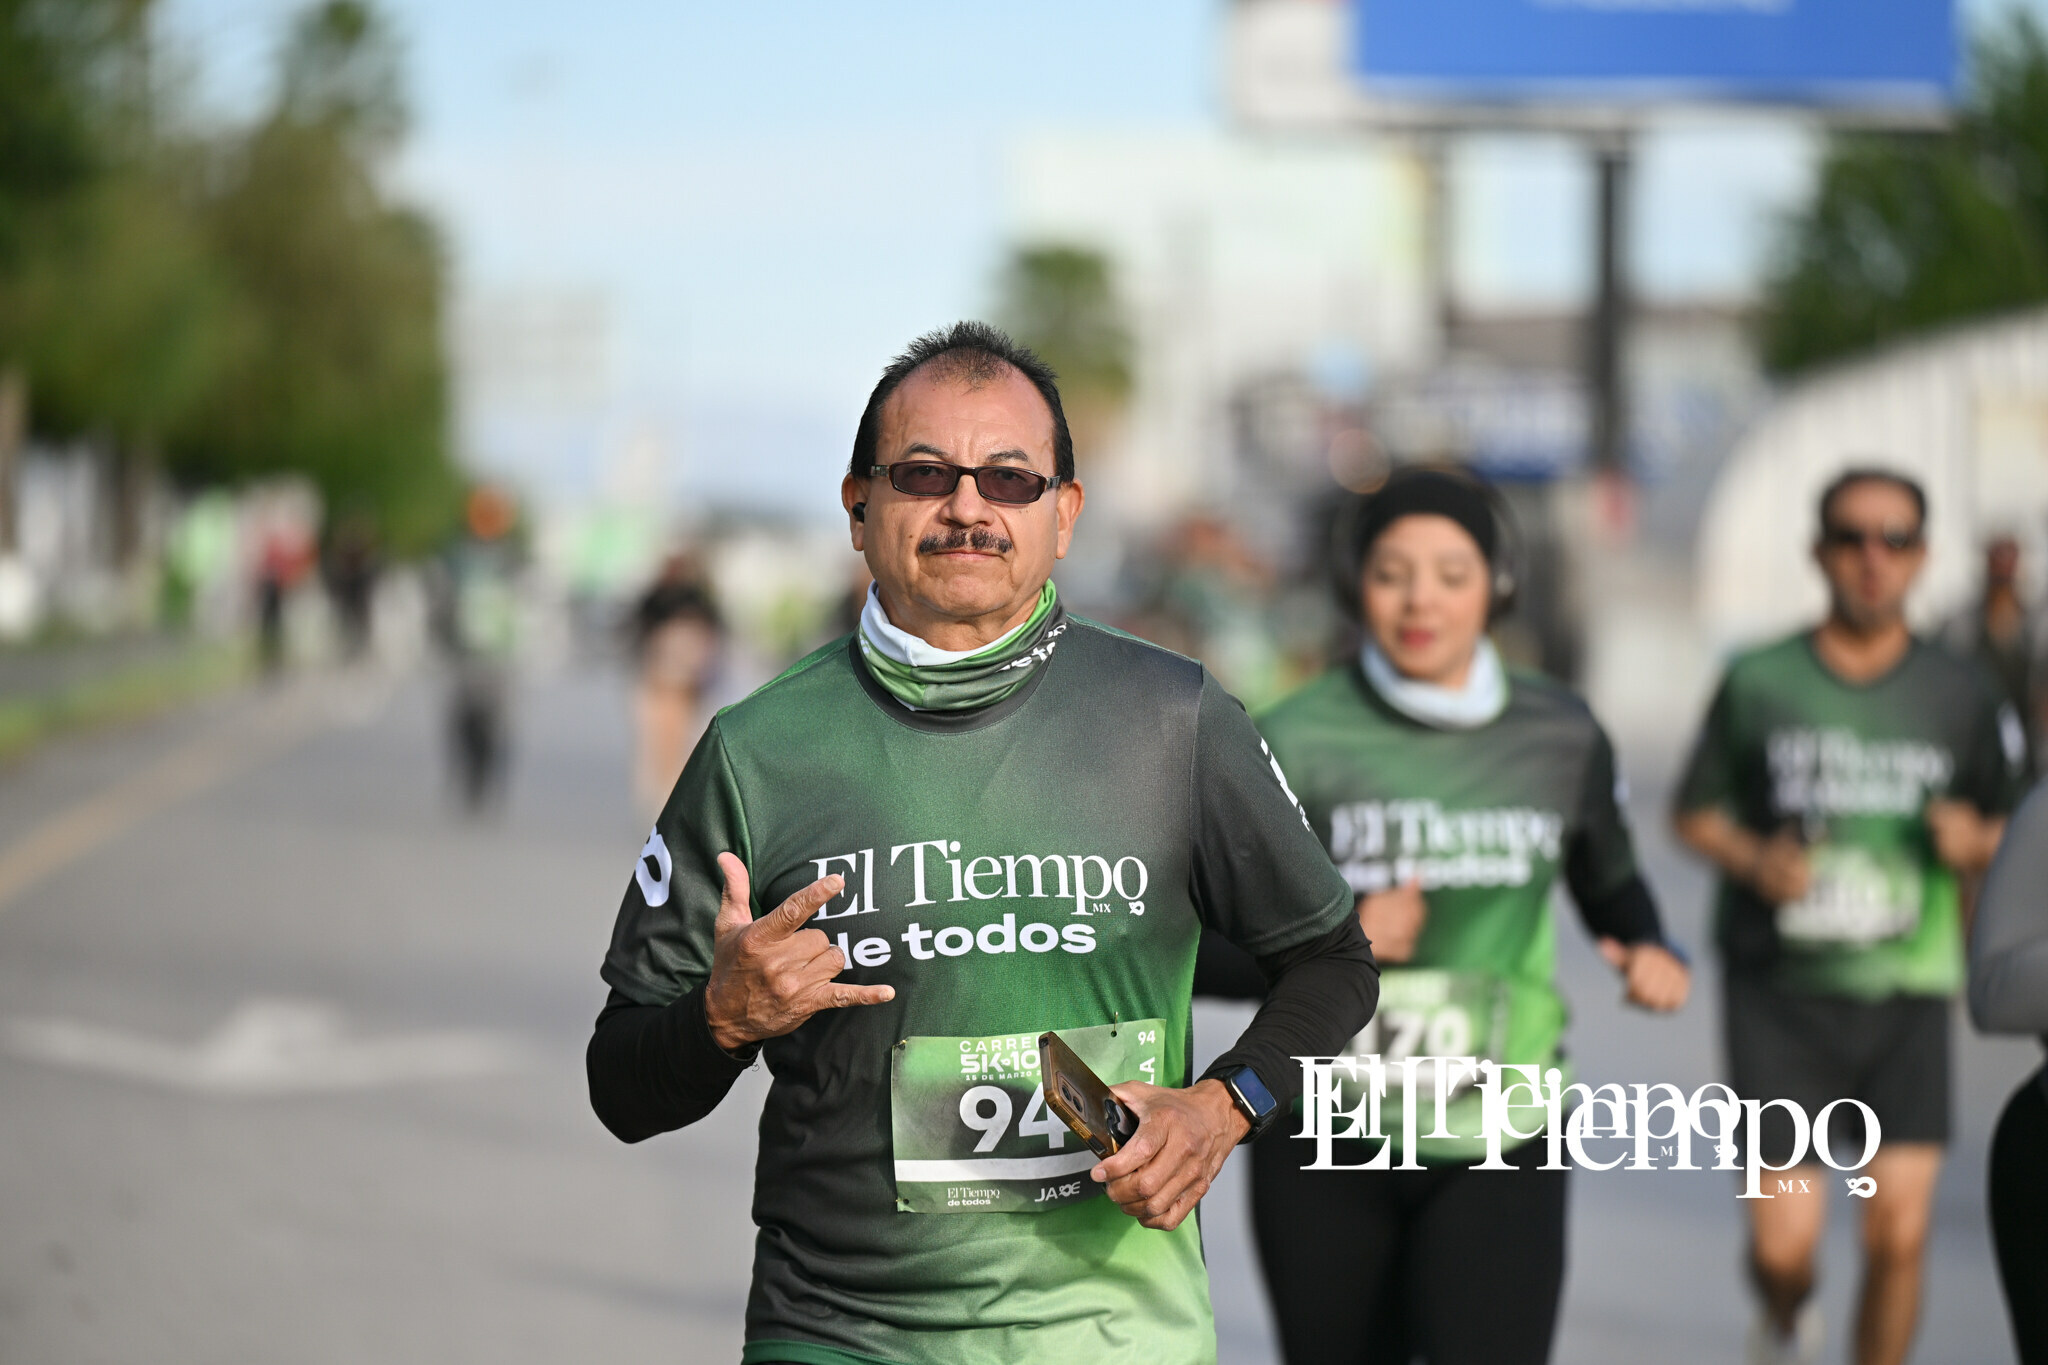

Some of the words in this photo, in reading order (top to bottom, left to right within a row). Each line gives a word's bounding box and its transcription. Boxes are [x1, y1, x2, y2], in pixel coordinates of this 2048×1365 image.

[809, 848, 880, 921] El
[891, 839, 1148, 916] Tiempo
[1093, 902, 1112, 914] MX
[901, 913, 1097, 960] todos
[1137, 1030, 1156, 1046] 94
[999, 1070, 1033, 1080] MARZO
[959, 1082, 1072, 1153] 94
[947, 1187, 959, 1198] El
[947, 1199, 960, 1207] de
[962, 1198, 992, 1206] todos
